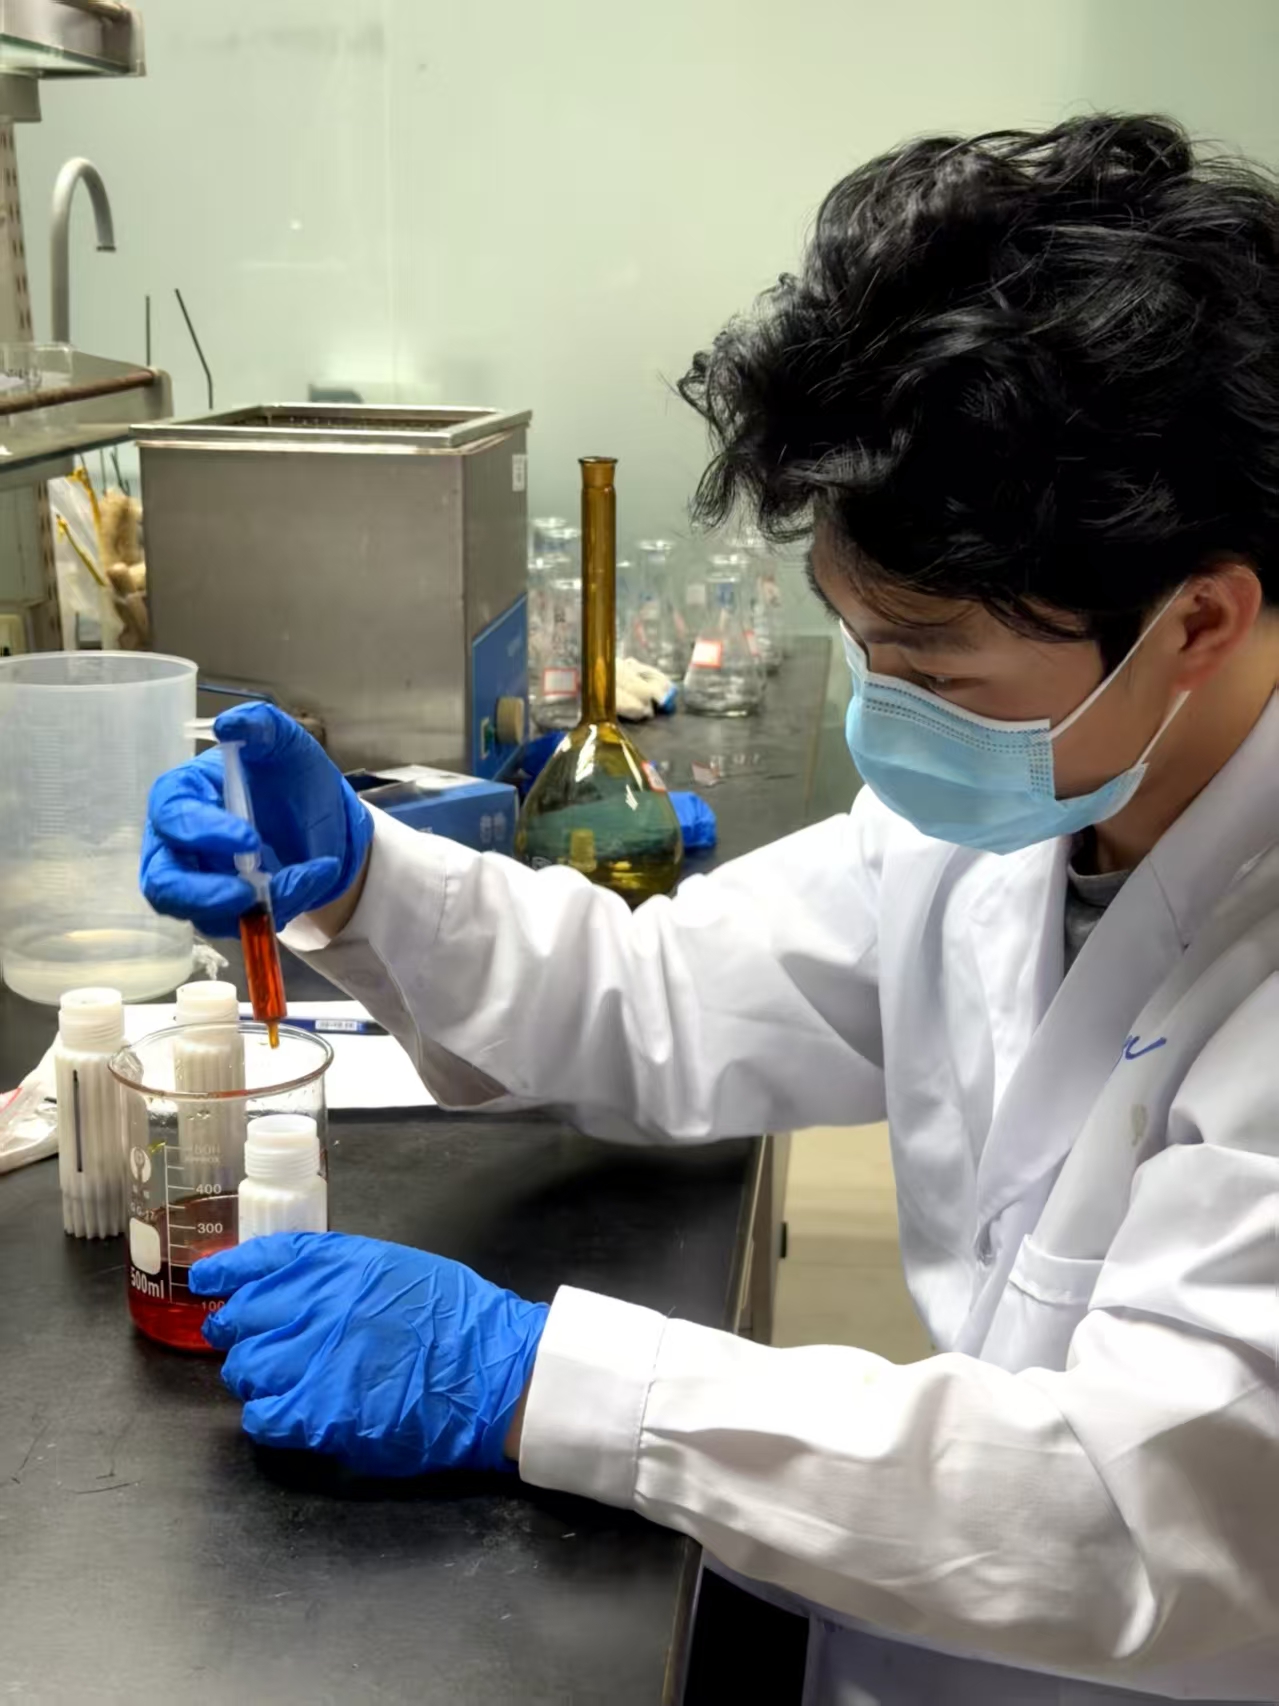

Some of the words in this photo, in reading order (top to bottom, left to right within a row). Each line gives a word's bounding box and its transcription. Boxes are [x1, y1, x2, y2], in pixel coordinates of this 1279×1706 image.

[196, 1183, 222, 1195] 400
[197, 1223, 223, 1234] 300
[131, 1267, 164, 1299] 500ml
